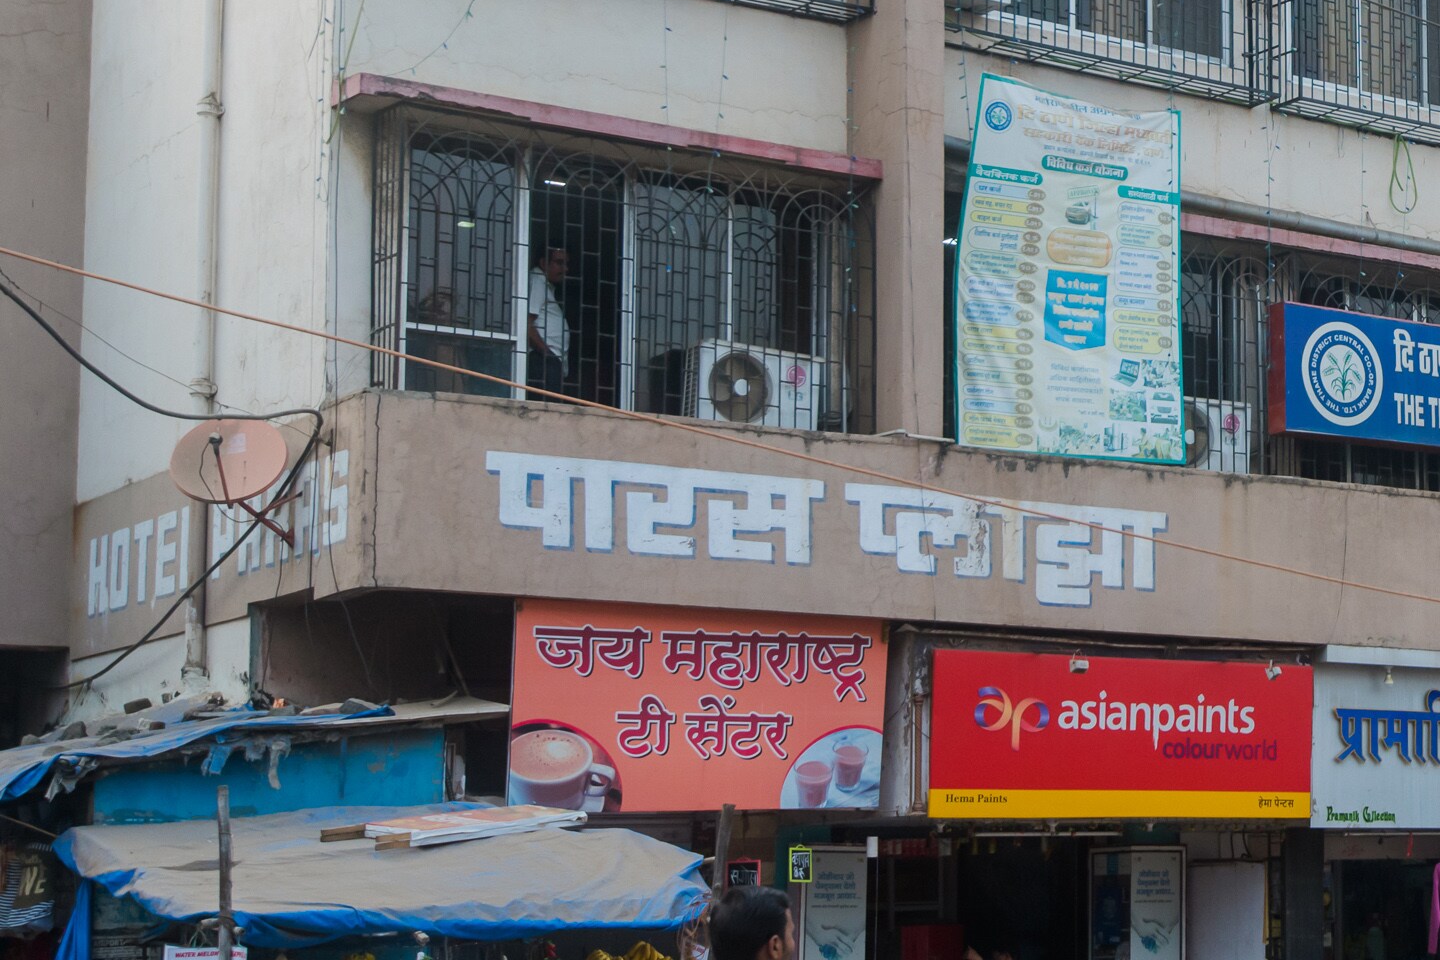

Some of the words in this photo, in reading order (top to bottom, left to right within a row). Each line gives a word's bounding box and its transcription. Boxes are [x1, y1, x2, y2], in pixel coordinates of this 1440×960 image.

[1394, 329, 1415, 373] दि
[1394, 393, 1425, 427] THE
[486, 450, 825, 566] पारस
[845, 482, 1168, 608] प्लाझा
[533, 623, 652, 679] जय
[661, 628, 873, 702] महाराष्ट्र
[615, 693, 676, 757] टी
[683, 694, 794, 759] सेंटर
[1057, 689, 1255, 751] asianpaints
[945, 792, 975, 804] Hema
[977, 792, 1008, 805] Paints
[1258, 795, 1273, 808] हेमा
